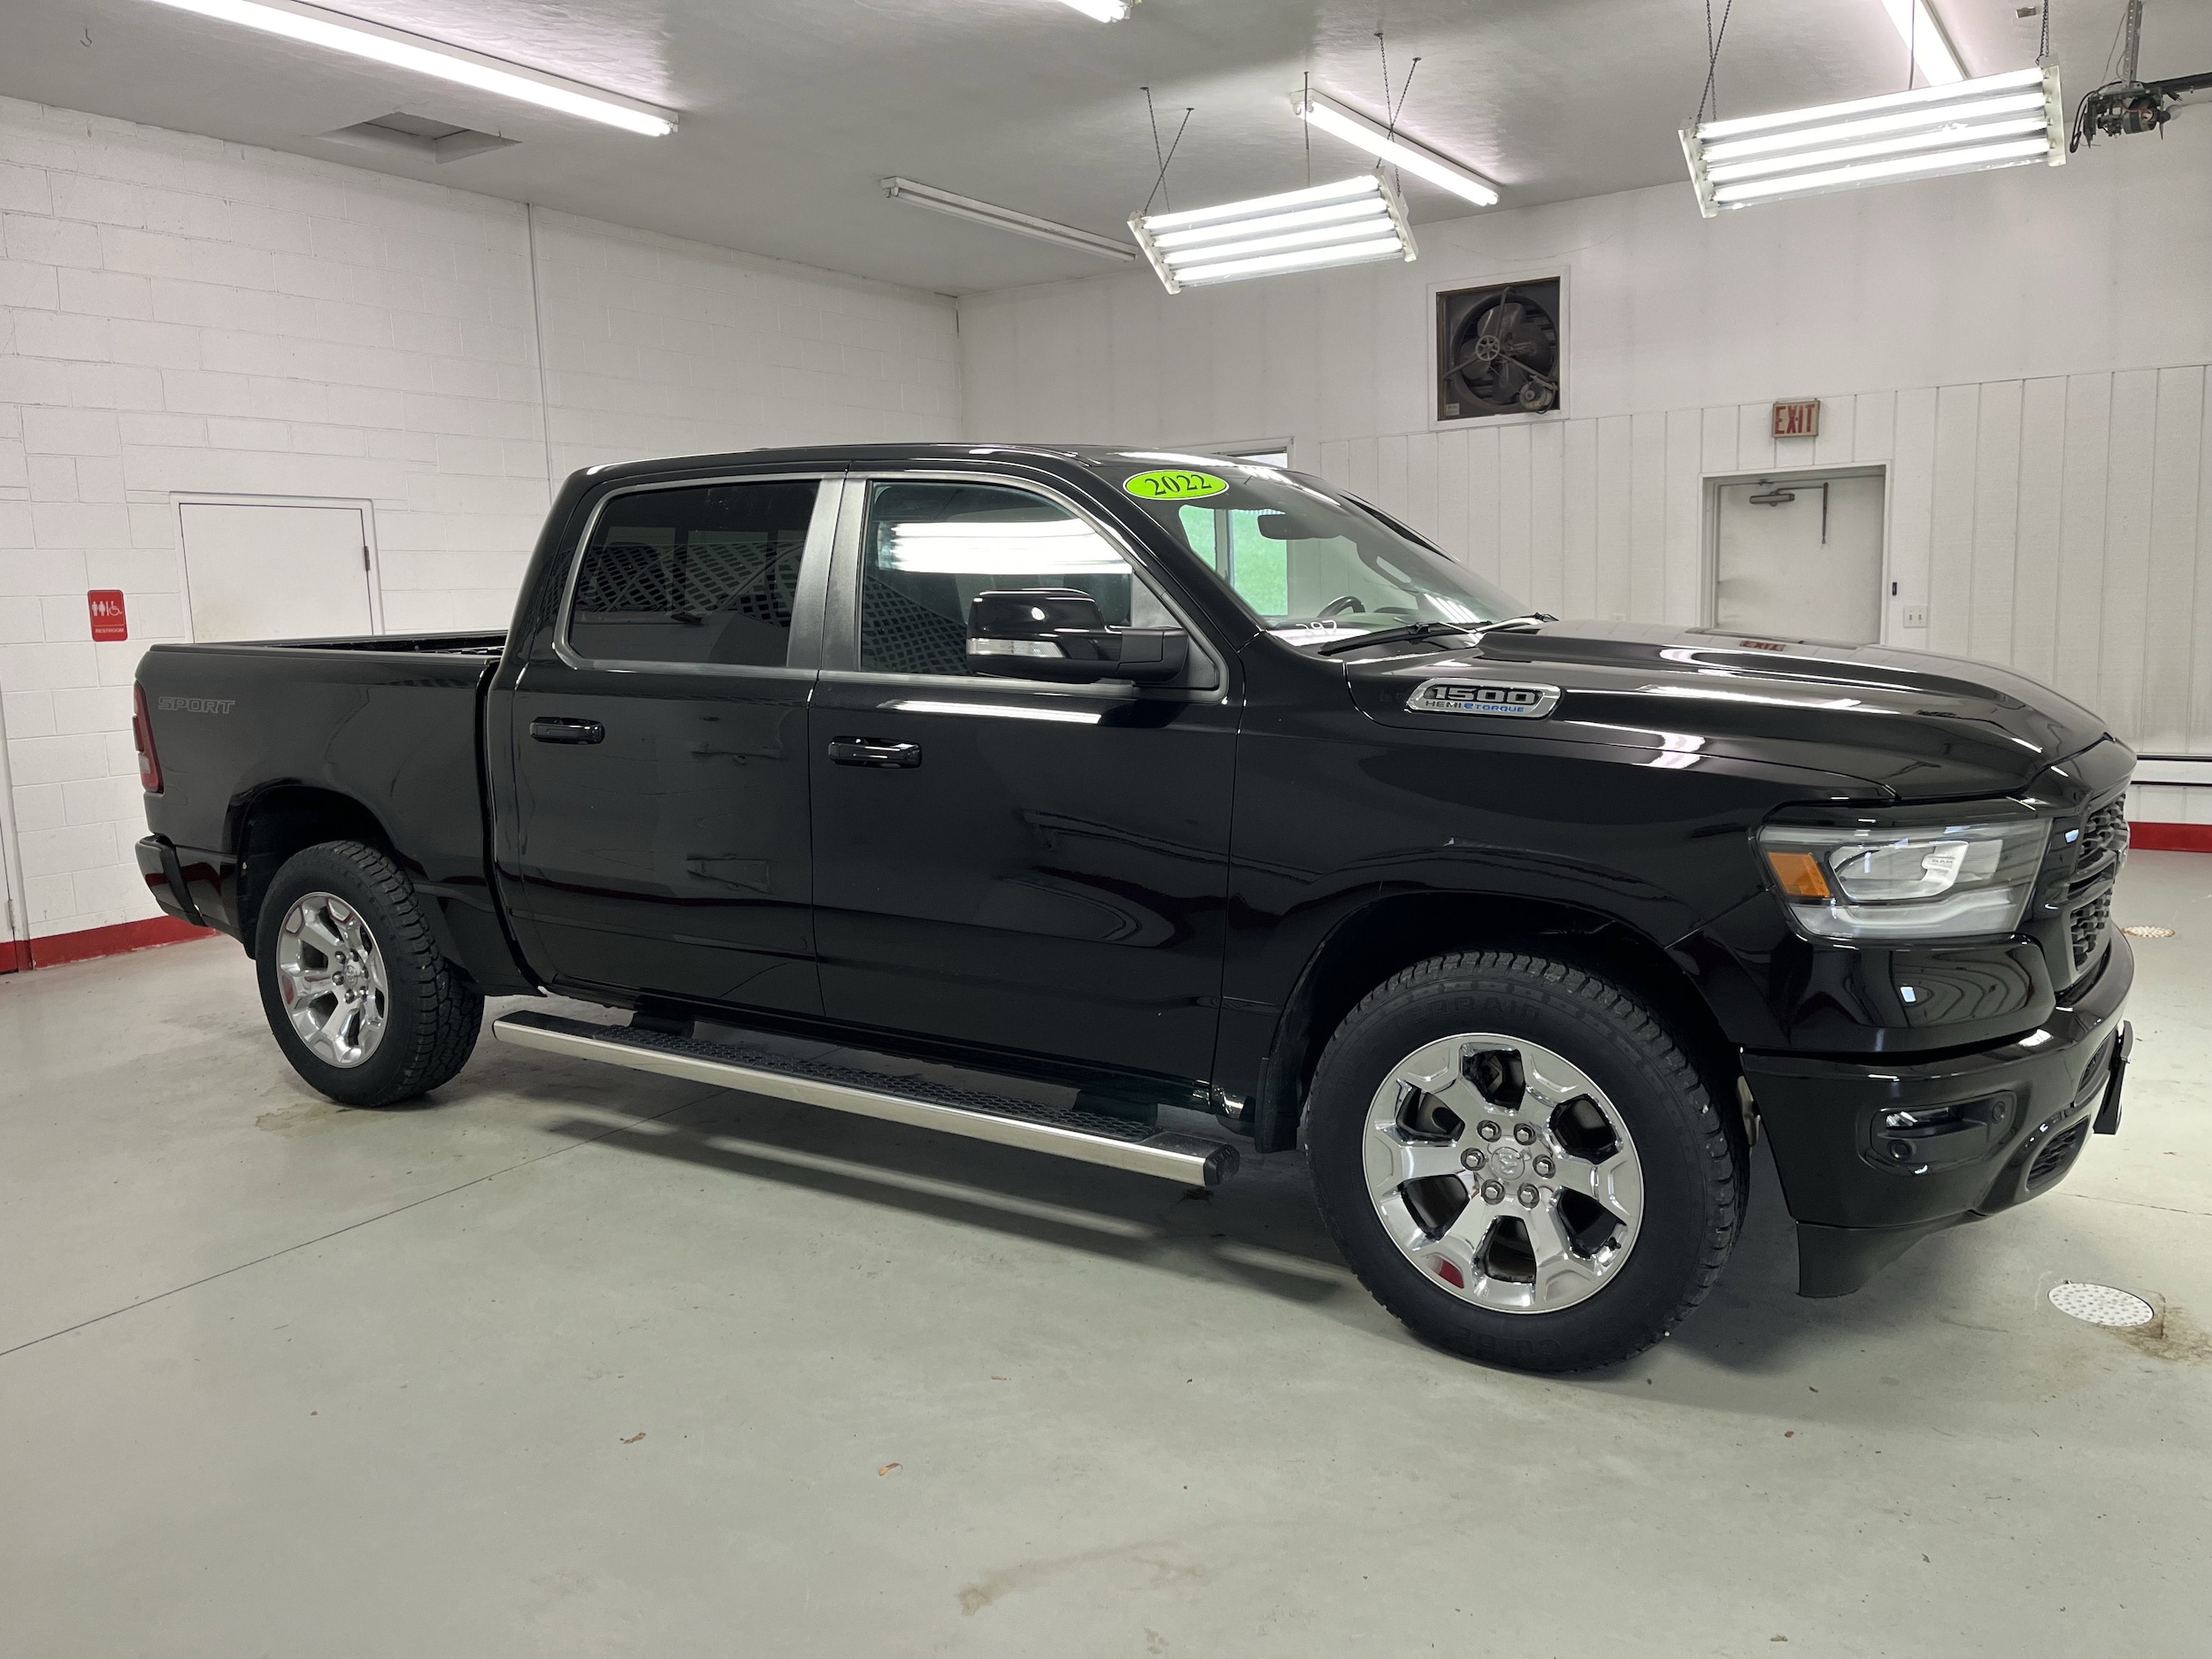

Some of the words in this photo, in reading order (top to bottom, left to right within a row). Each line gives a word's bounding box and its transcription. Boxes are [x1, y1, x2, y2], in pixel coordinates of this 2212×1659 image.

[1775, 403, 1816, 434] EXIT
[1144, 474, 1212, 495] 2022
[1425, 700, 1463, 709] HEMI
[1432, 686, 1536, 704] 1500
[158, 696, 235, 715] SPORT
[1386, 995, 1541, 1031] TERRAIN
